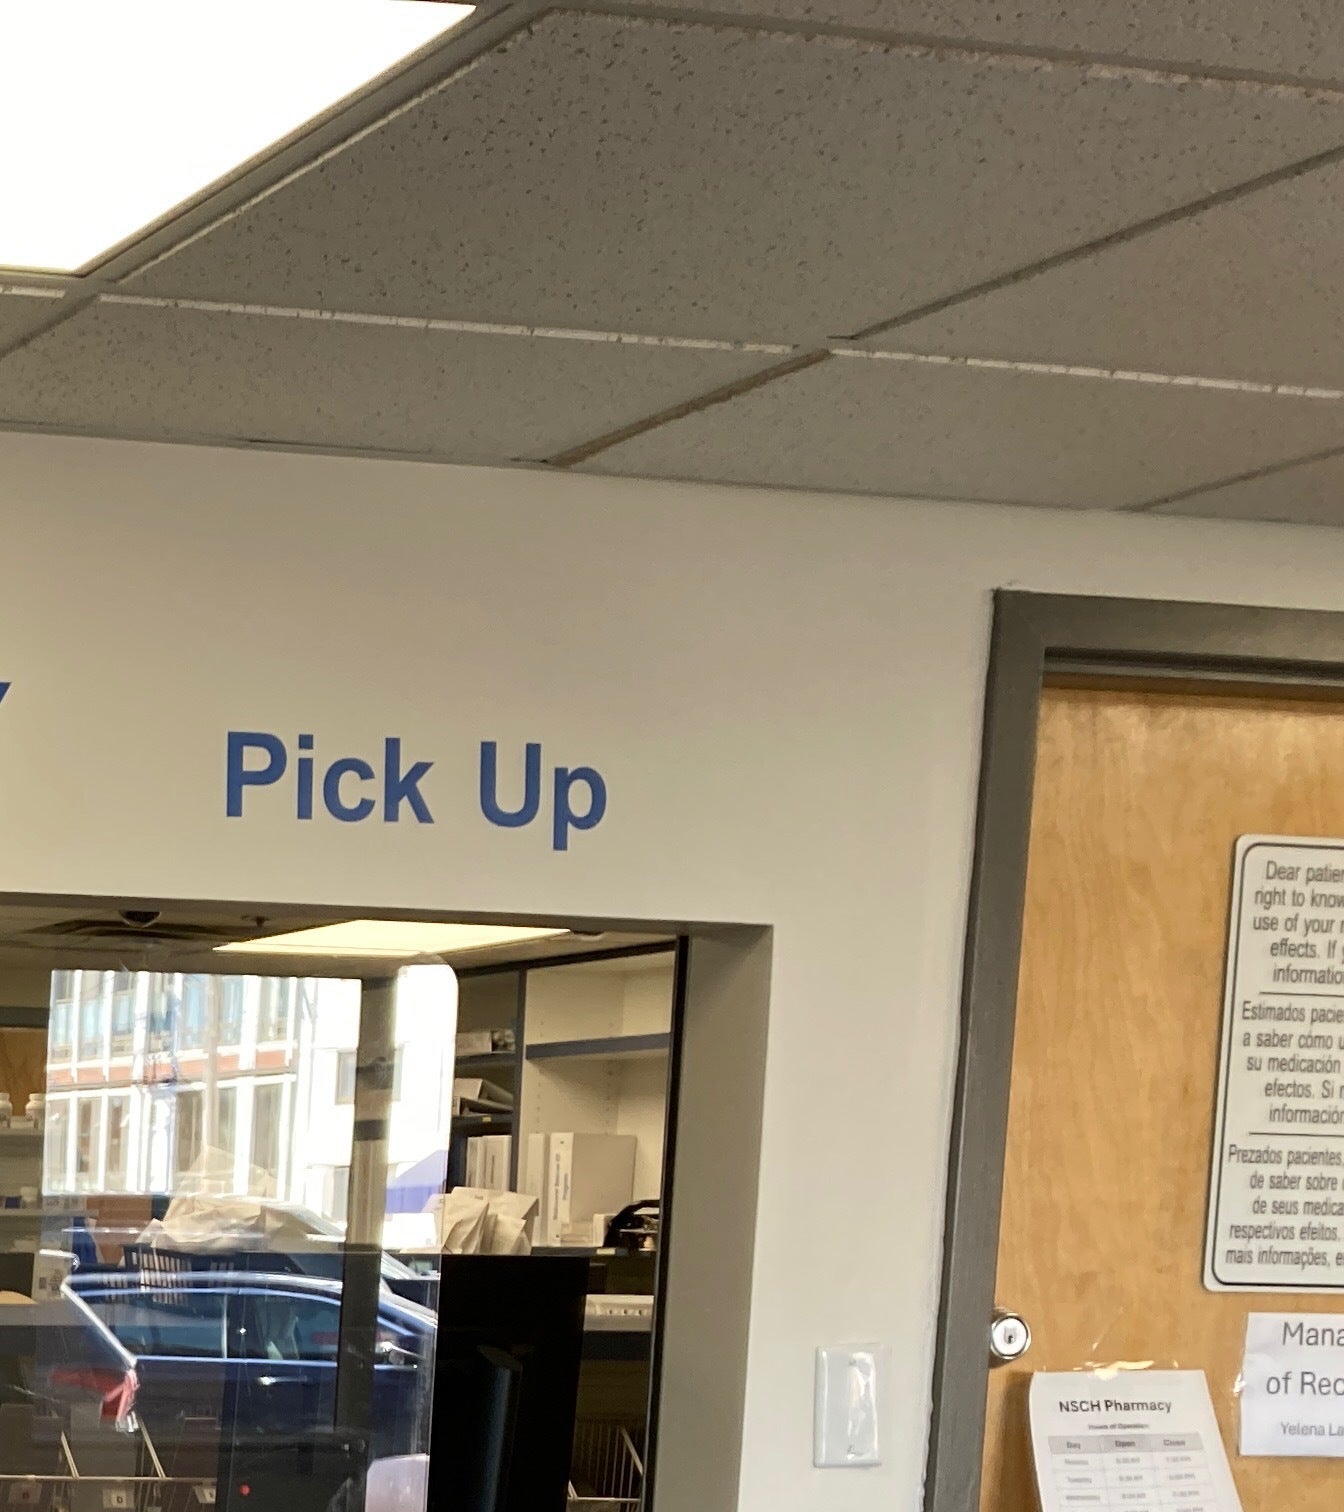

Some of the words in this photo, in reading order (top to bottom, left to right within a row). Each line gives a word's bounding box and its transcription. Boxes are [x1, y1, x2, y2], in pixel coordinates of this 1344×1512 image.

[226, 729, 433, 822] Pick
[480, 744, 606, 849] Up
[1265, 860, 1301, 880] Dear
[1254, 886, 1287, 910] right
[1292, 889, 1305, 907] to
[1252, 915, 1279, 931] use
[1284, 912, 1299, 932] of
[1303, 915, 1336, 937] your
[1270, 937, 1320, 958] effects.
[1242, 1000, 1306, 1022] Estimados
[1242, 1032, 1251, 1047] a
[1256, 1028, 1293, 1048] saber
[1298, 1029, 1333, 1049] cómo
[1247, 1056, 1262, 1071] su
[1267, 1053, 1341, 1073] medicación
[1264, 1078, 1315, 1098] efectos.
[1321, 1079, 1334, 1099] Si
[1228, 1144, 1283, 1164] Prezados
[1249, 1170, 1264, 1189] de
[1269, 1171, 1301, 1190] saber
[1305, 1172, 1338, 1191] sobre
[1252, 1196, 1267, 1214] de
[1271, 1200, 1298, 1215] seus
[1229, 1221, 1295, 1244] respectivos
[1225, 1245, 1253, 1264] mais
[1257, 1245, 1330, 1270] informações,
[1266, 1371, 1292, 1395] of
[1059, 1400, 1101, 1413] NSCH
[1104, 1399, 1172, 1414] Pharmacy
[1280, 1421, 1325, 1436] Yelena
